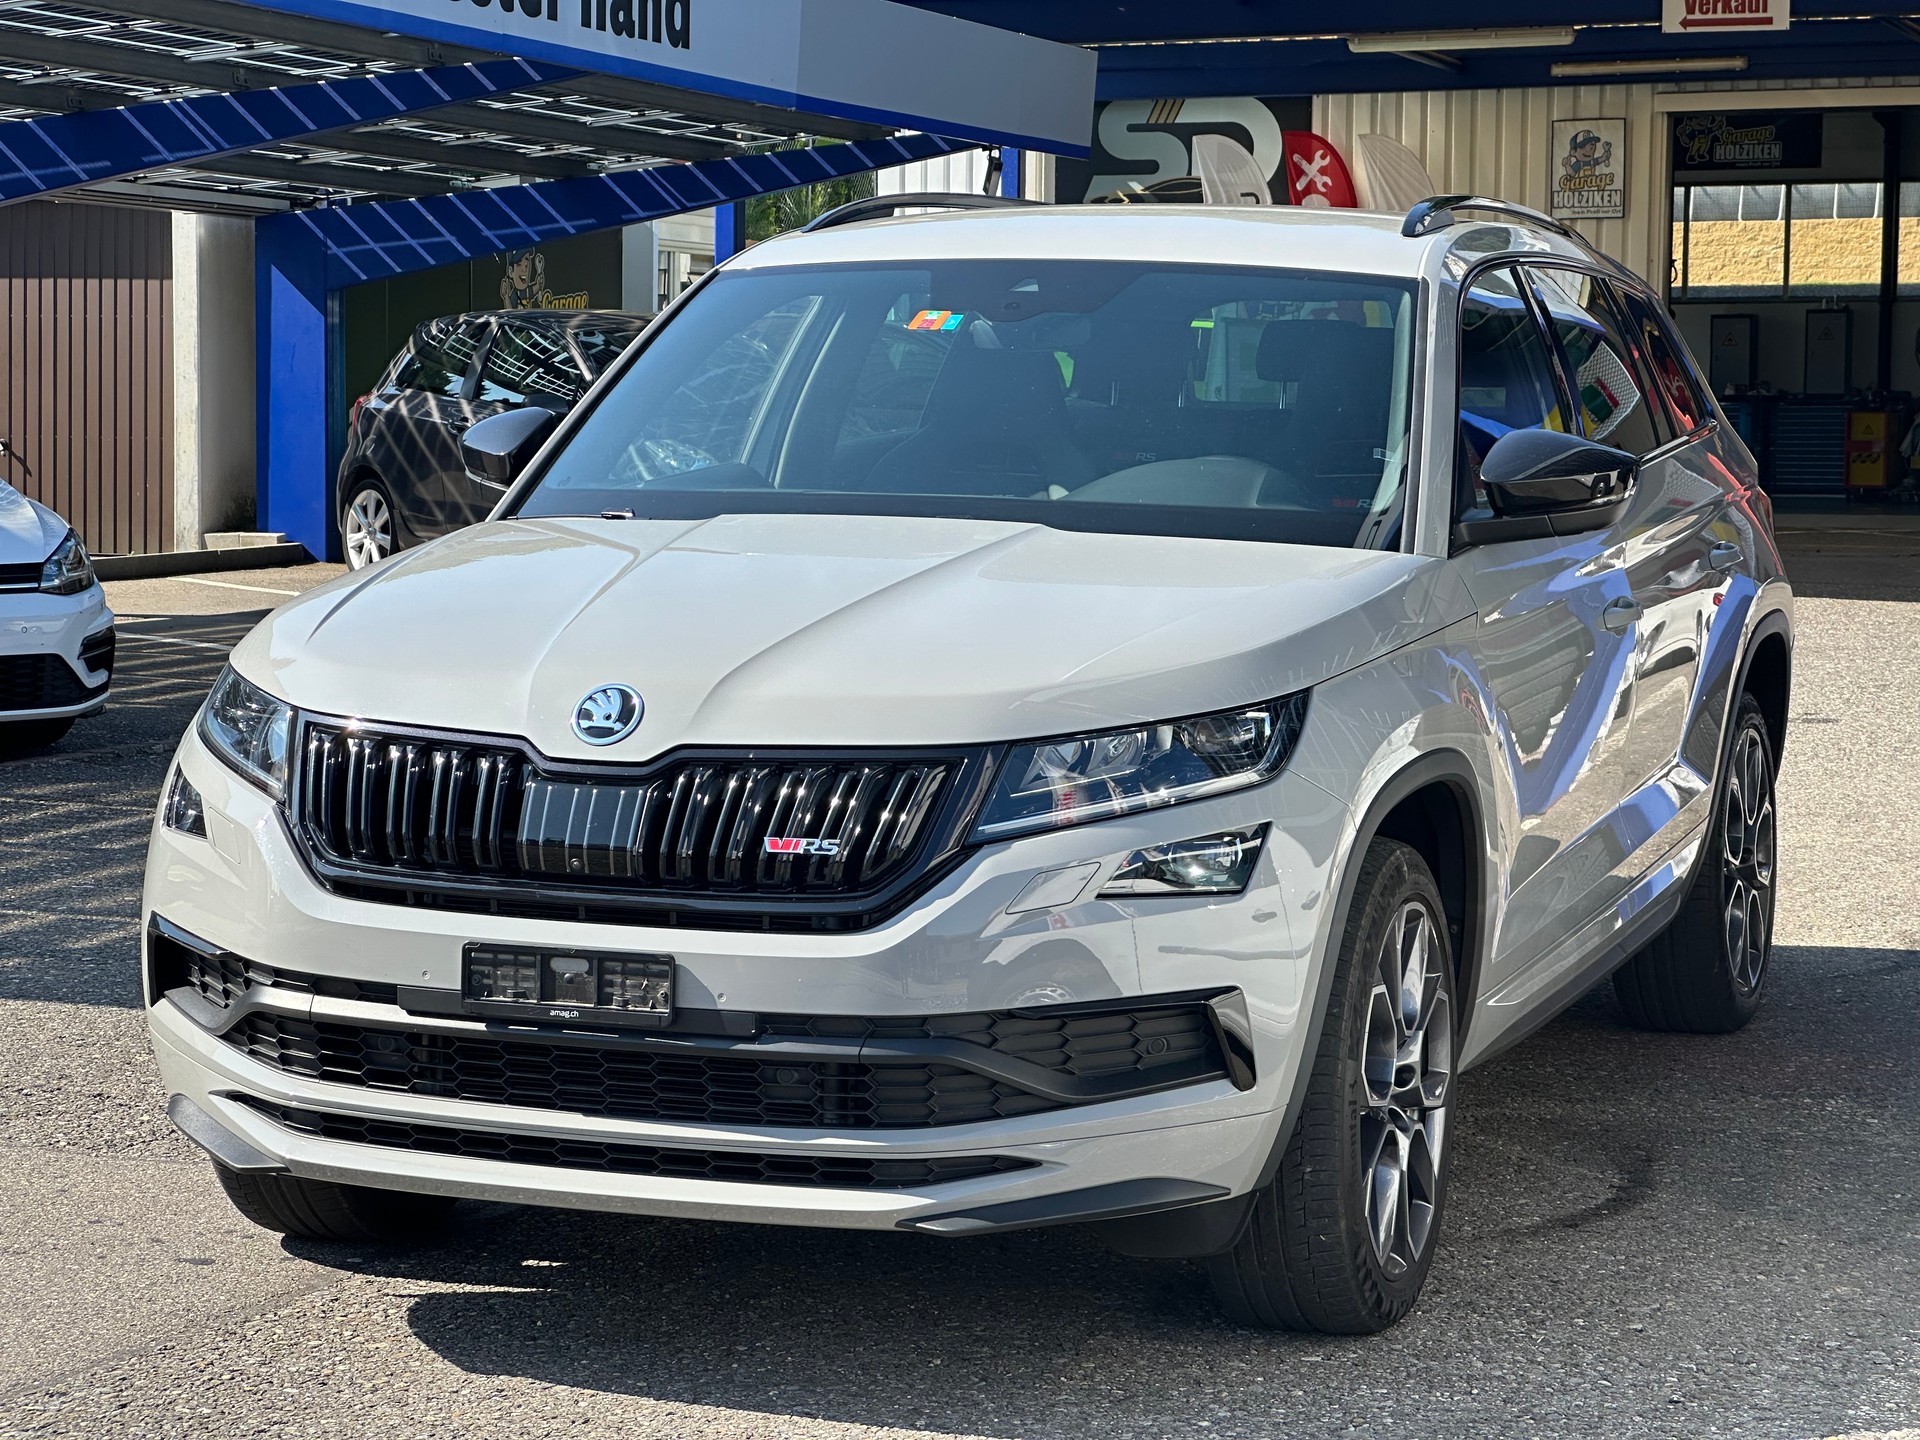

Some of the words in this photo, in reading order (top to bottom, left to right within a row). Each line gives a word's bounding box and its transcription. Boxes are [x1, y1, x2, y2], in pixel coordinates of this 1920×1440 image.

[1722, 127, 1773, 145] Garage
[1715, 143, 1780, 160] HOLZIKEN
[1559, 173, 1614, 192] Garage
[1552, 190, 1621, 208] HOLZIKEN
[549, 1009, 579, 1018] amag.ch
